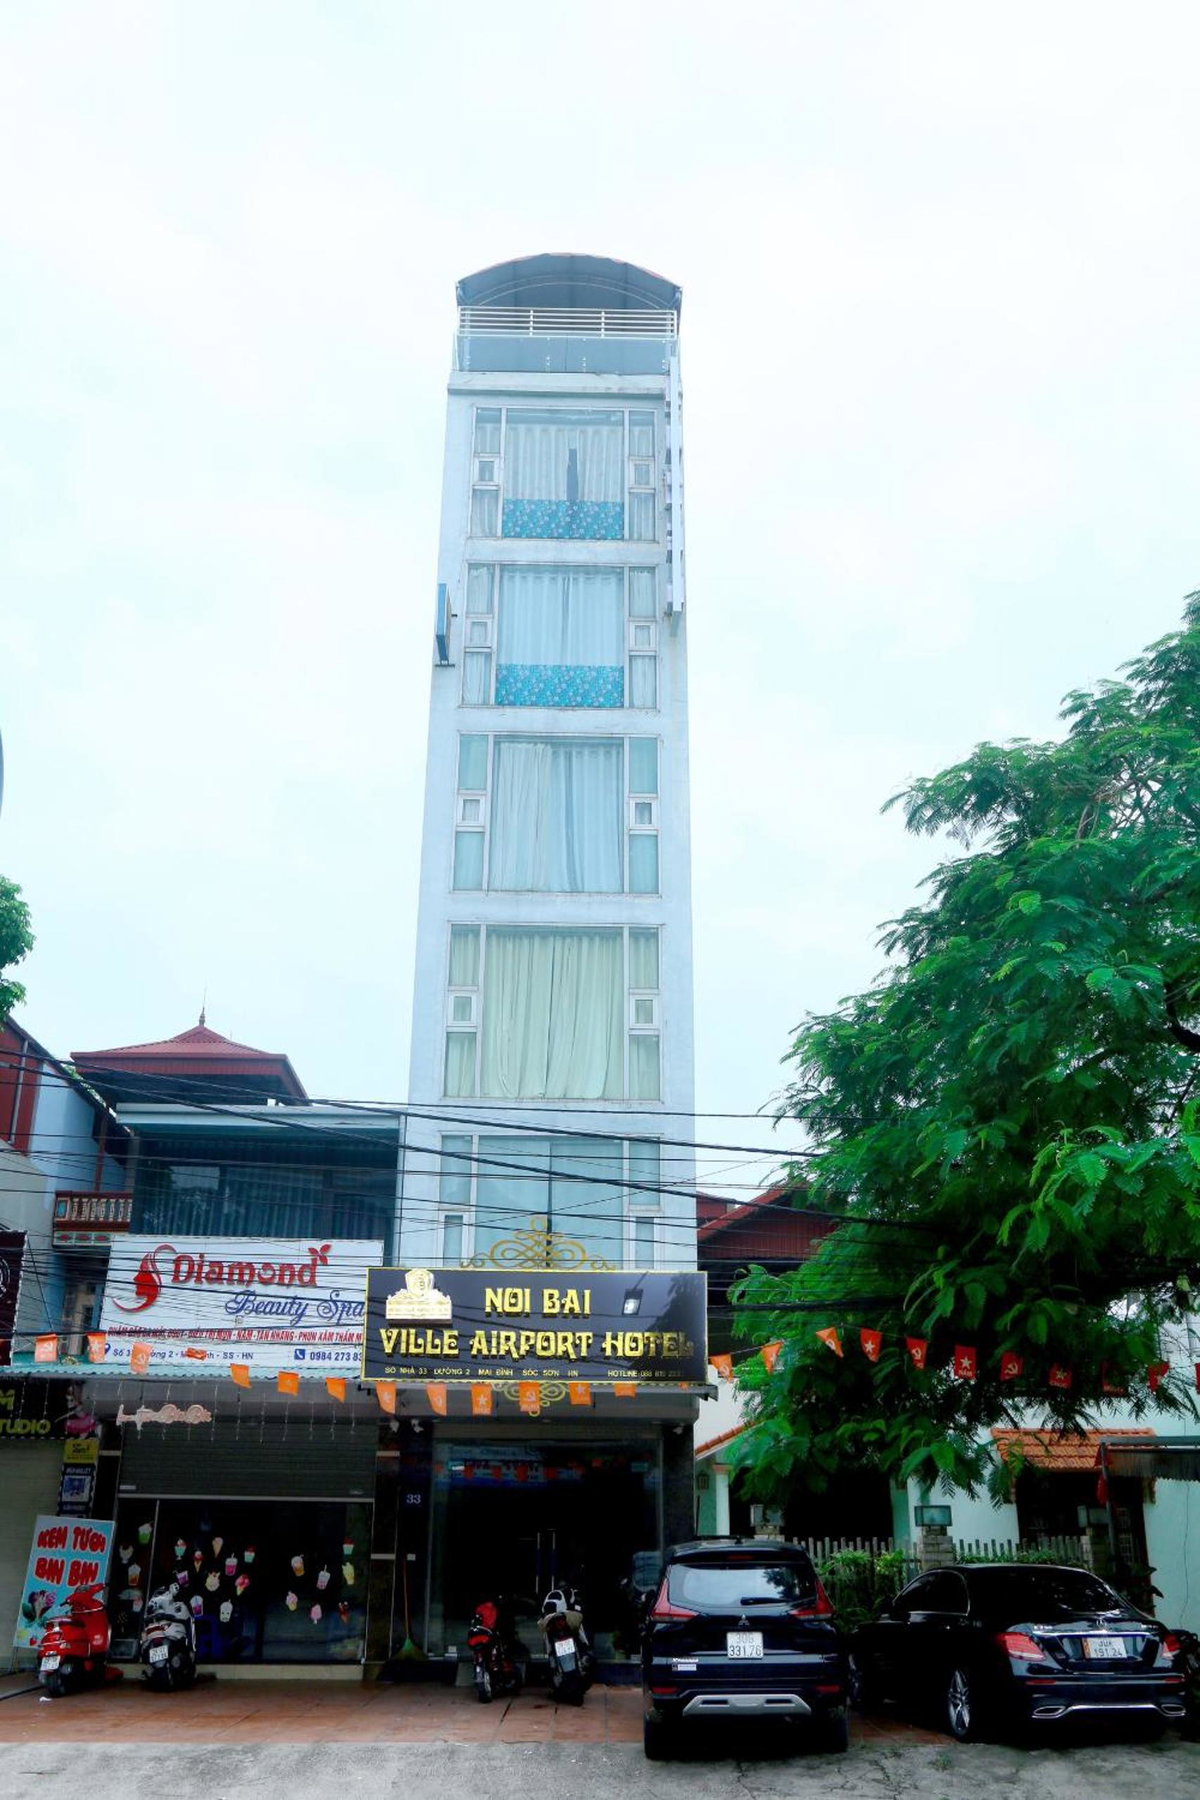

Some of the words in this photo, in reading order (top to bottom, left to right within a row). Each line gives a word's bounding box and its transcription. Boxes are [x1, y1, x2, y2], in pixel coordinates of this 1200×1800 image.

[171, 1253, 318, 1287] Diamond
[225, 1290, 309, 1326] Beauty
[317, 1290, 365, 1325] Spa
[485, 1287, 531, 1316] NOI
[543, 1288, 591, 1316] BAI
[242, 1352, 254, 1360] HN
[310, 1351, 332, 1361] 0984
[334, 1351, 351, 1361] 273
[379, 1328, 460, 1357] VILLE
[469, 1329, 594, 1361] AIRPORT
[602, 1331, 695, 1358] HOTEL
[406, 1493, 421, 1504] 33
[38, 1526, 68, 1549] KEM
